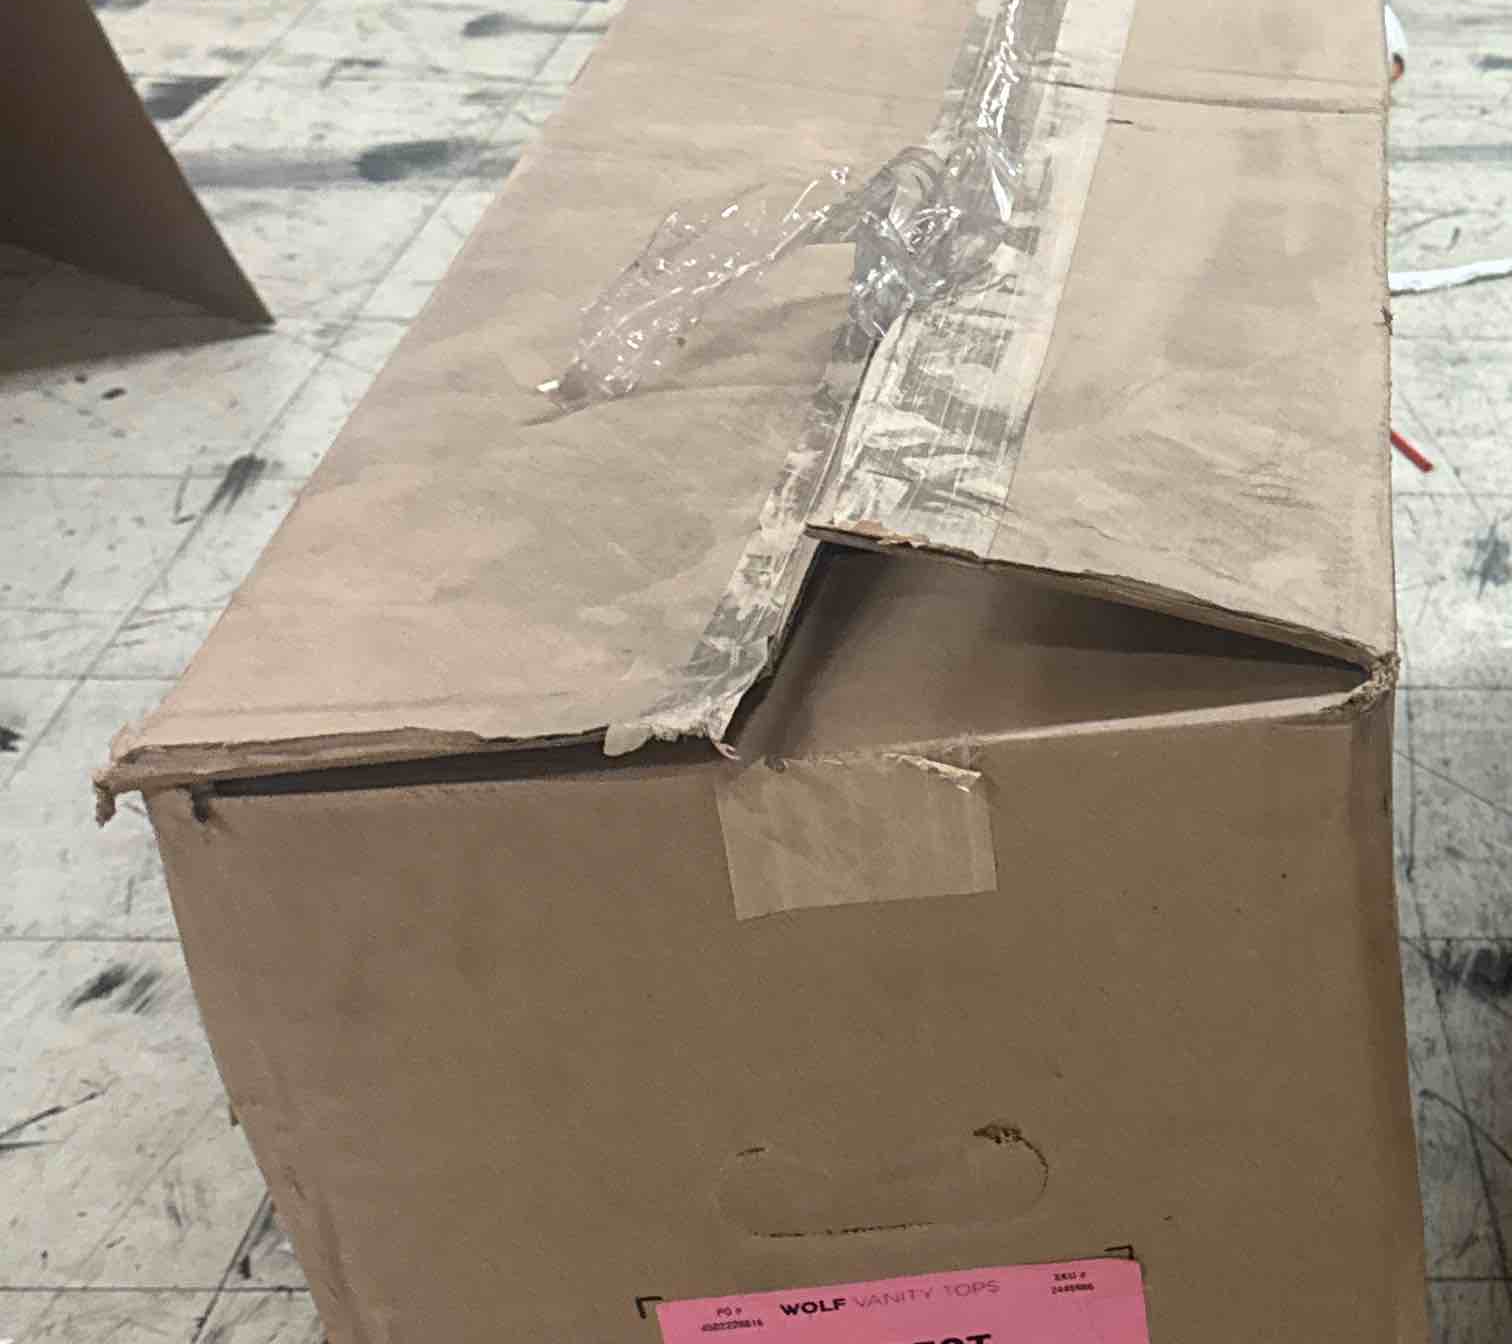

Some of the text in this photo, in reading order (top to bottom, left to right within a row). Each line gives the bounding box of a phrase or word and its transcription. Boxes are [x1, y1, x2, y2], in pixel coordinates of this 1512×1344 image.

[779, 1278, 1002, 1316] WOLF VANITY TOPS
